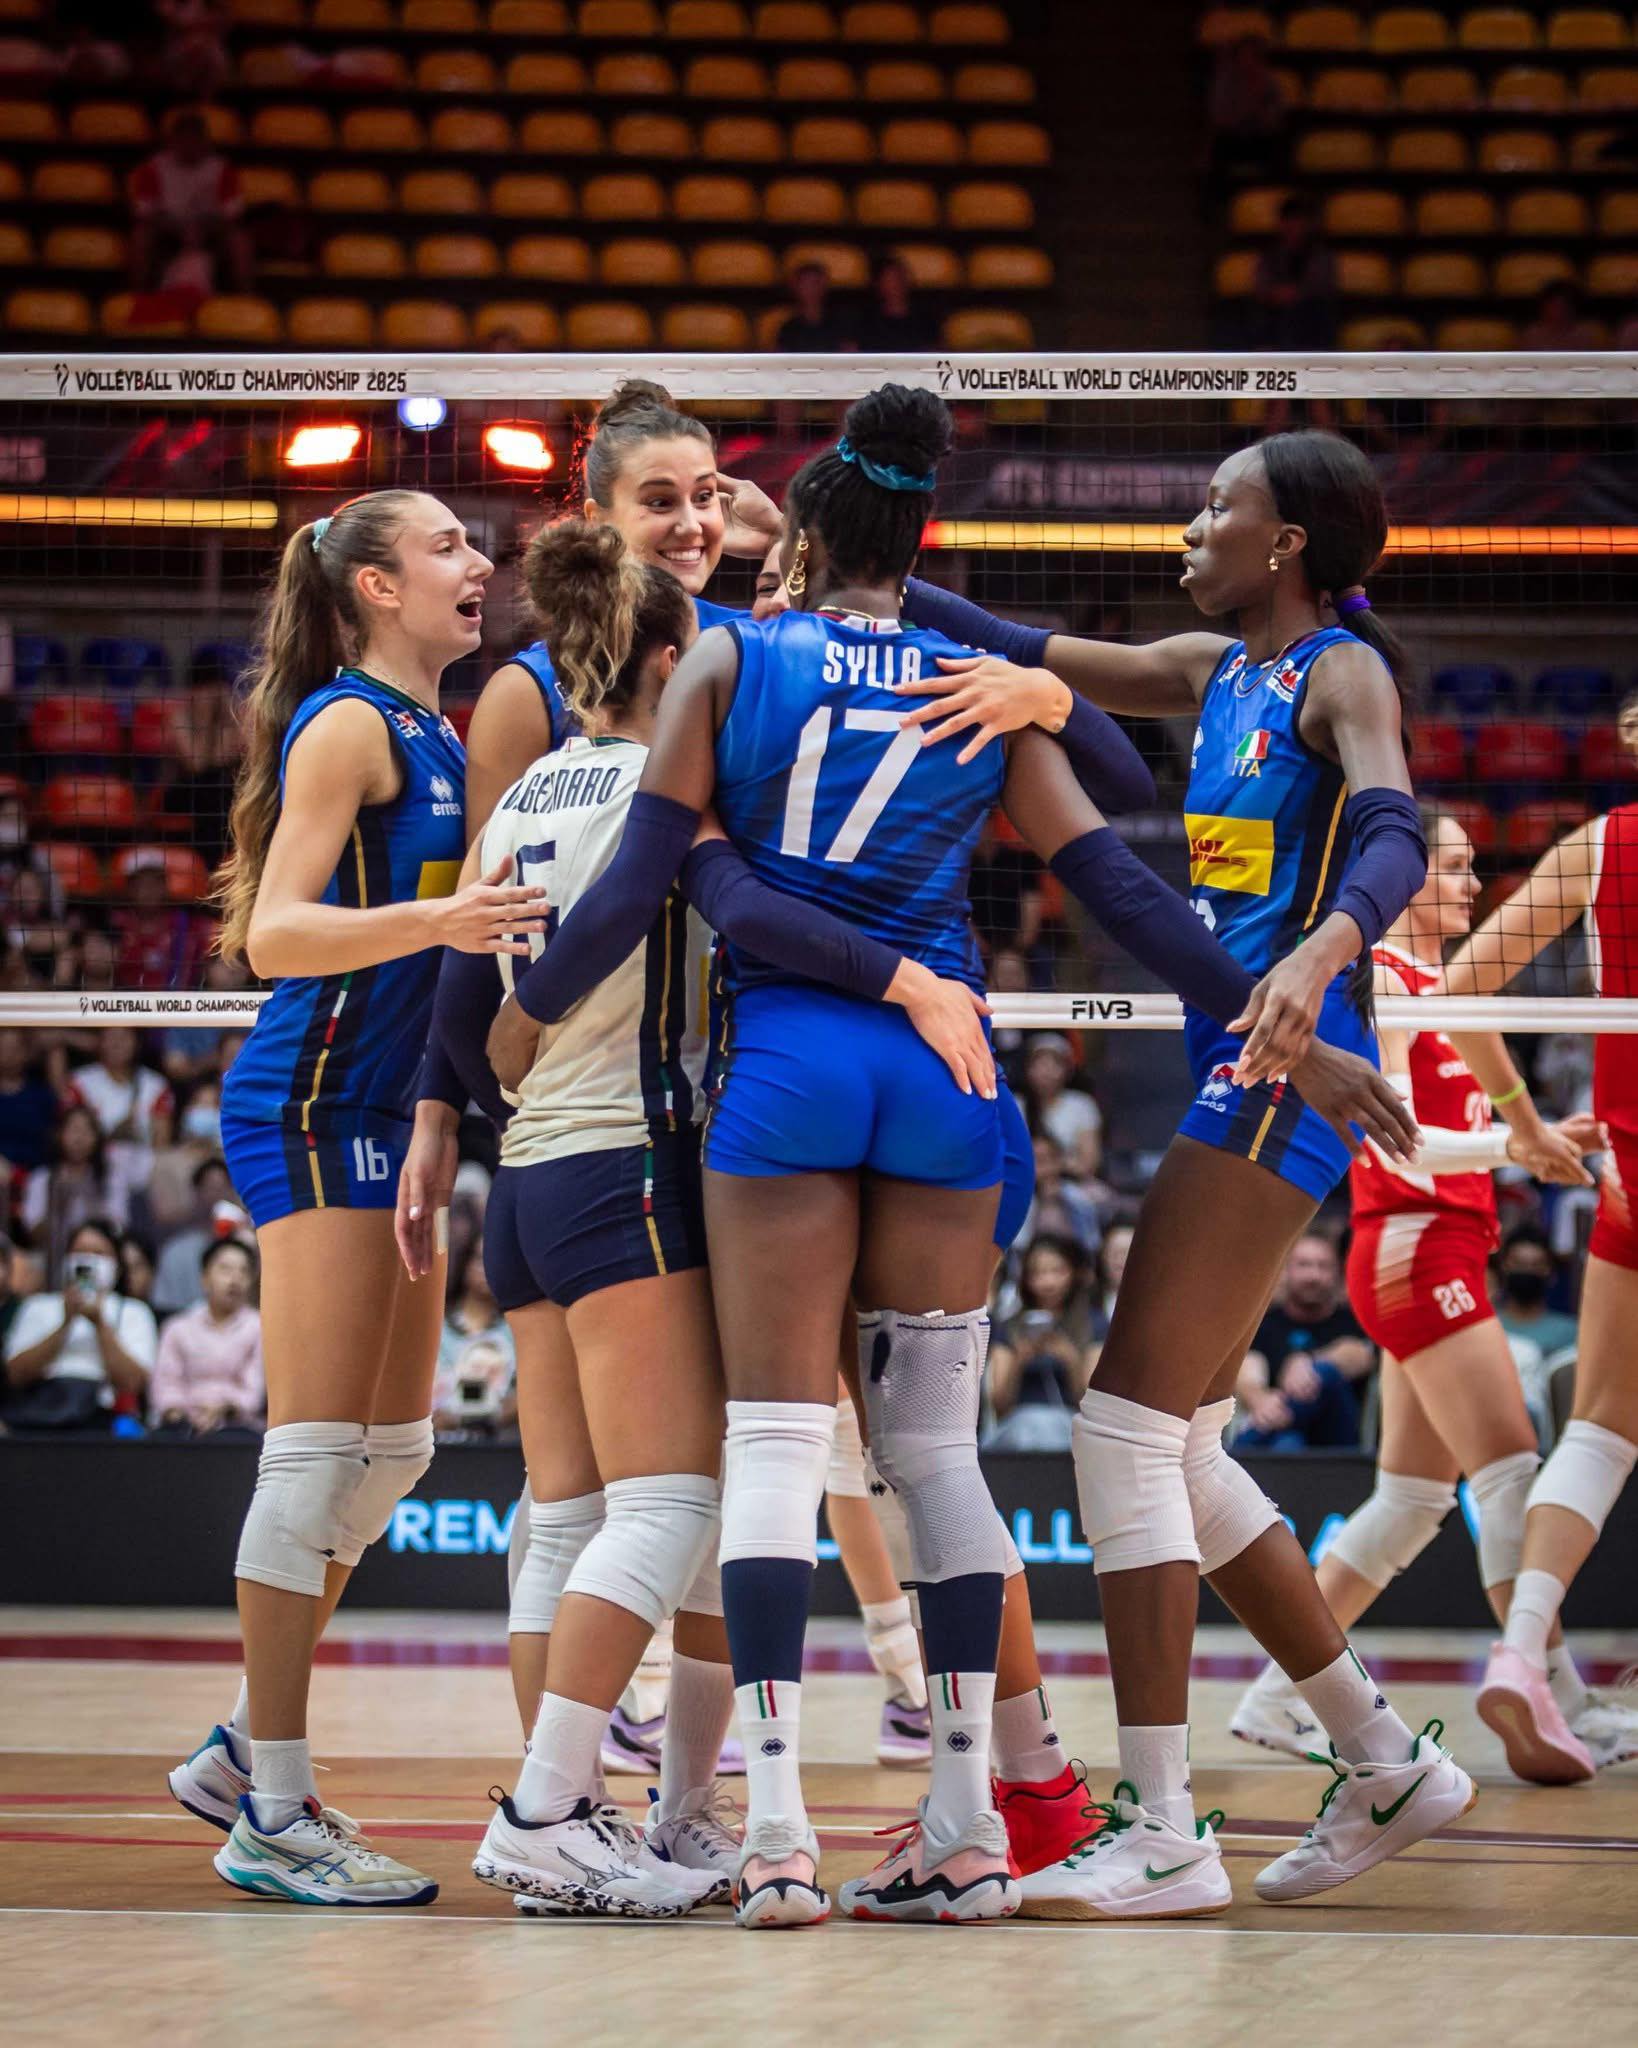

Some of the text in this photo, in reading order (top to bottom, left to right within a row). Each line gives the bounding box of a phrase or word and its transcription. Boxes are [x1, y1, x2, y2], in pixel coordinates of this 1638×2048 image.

[75, 371, 172, 391] VOLLEYBALL
[179, 370, 235, 391] WORLD
[243, 370, 360, 391] CHAMPIONSHIP
[958, 369, 1058, 390] VOLLEYBALL
[1064, 368, 1122, 390] WORLD
[1129, 369, 1249, 391] CHAMPIONSHIP
[823, 640, 922, 692] SYLLA
[1231, 759, 1261, 777] ITA
[780, 705, 926, 863] 17
[92, 1000, 152, 1012] VOLLEYBALL
[157, 1000, 192, 1012] WORLD
[1072, 1000, 1133, 1020] FIVB
[353, 1137, 389, 1181] 16
[1432, 1279, 1476, 1319] 26
